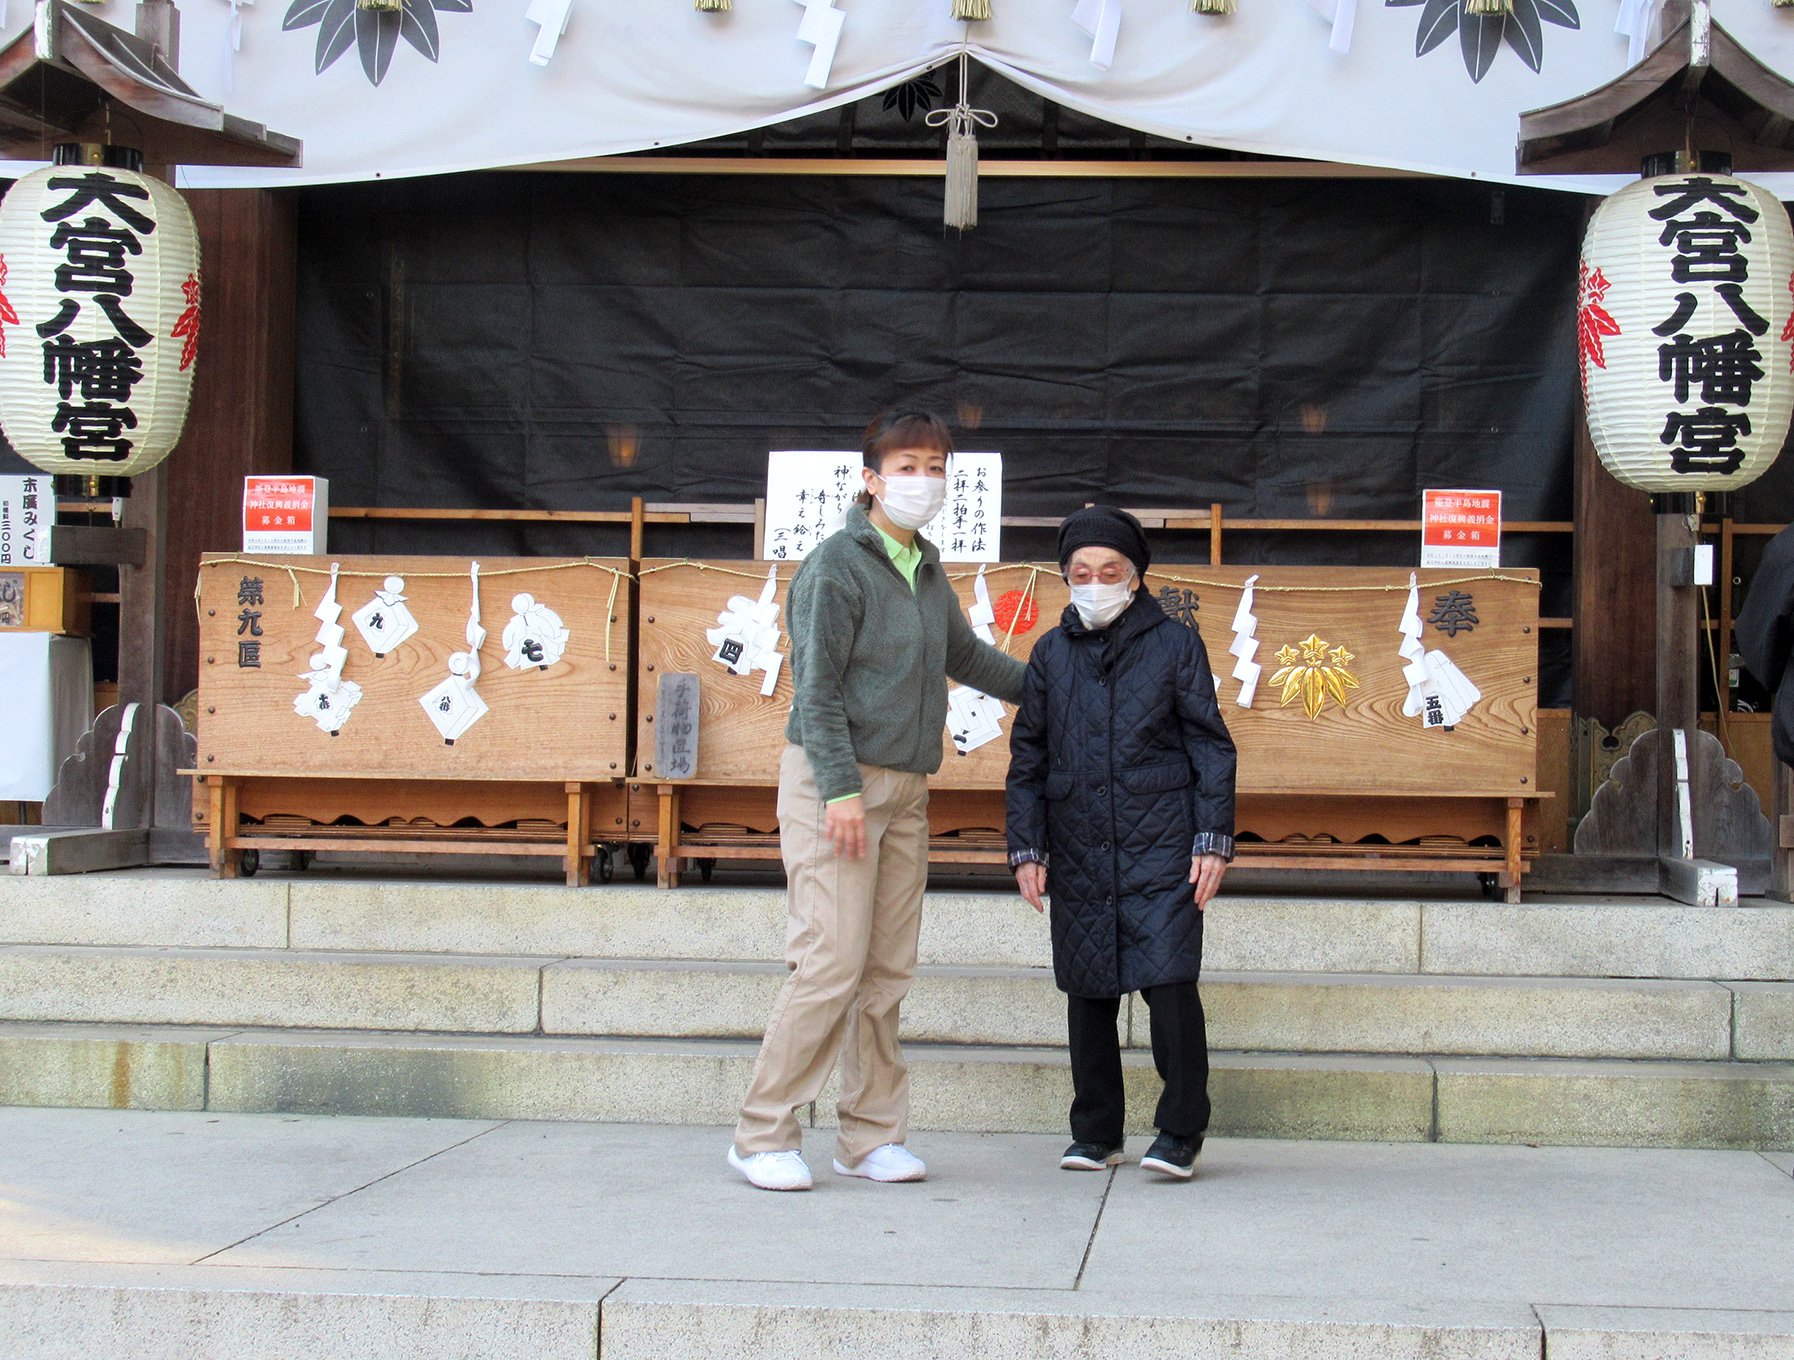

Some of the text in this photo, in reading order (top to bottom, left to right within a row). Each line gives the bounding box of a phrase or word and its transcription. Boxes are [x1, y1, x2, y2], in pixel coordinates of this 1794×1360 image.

[36, 172, 157, 462] 大宮八幡宮
[1648, 177, 1770, 476] 大宮八幡宮
[834, 465, 849, 514] 神ながら
[951, 470, 969, 553] 二拝二拍手一拝
[970, 467, 989, 552] お参りの作法
[1434, 497, 1490, 509] 能登半島地震
[1427, 590, 1480, 638] 奉
[1425, 695, 1444, 725] 五番
